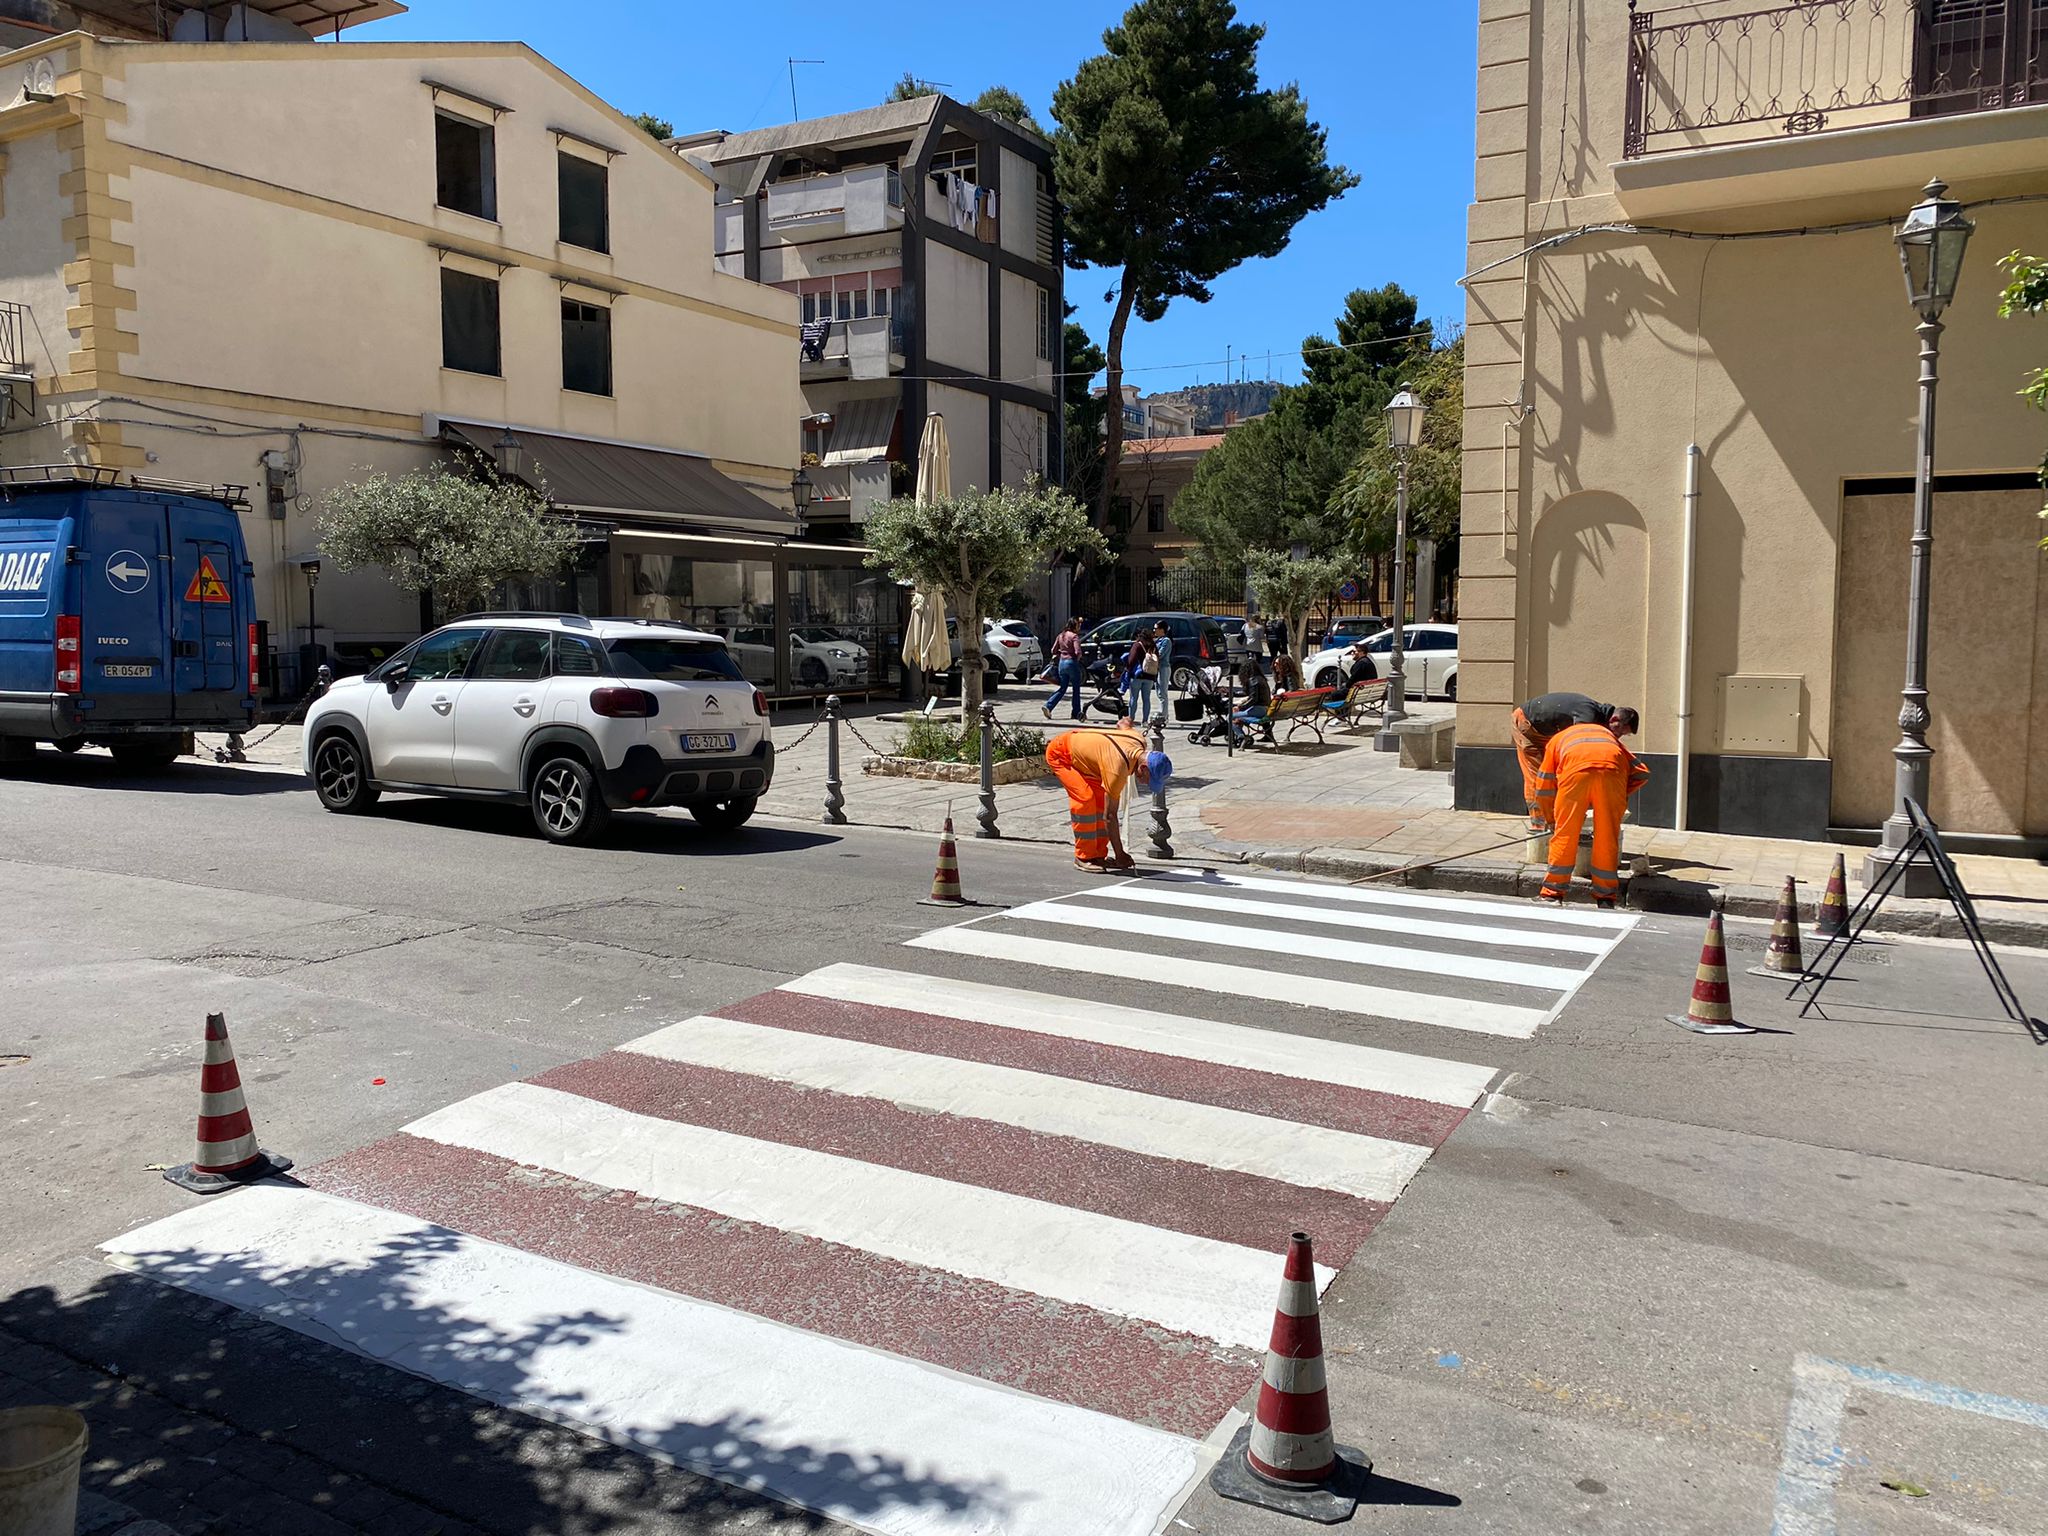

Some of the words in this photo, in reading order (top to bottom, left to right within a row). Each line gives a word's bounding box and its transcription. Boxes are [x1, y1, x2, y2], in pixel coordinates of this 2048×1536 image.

[0, 552, 51, 590] DALE
[98, 637, 129, 645] IVECO
[106, 666, 118, 676] ER
[121, 666, 150, 676] 054PY
[702, 735, 730, 748] 327LA
